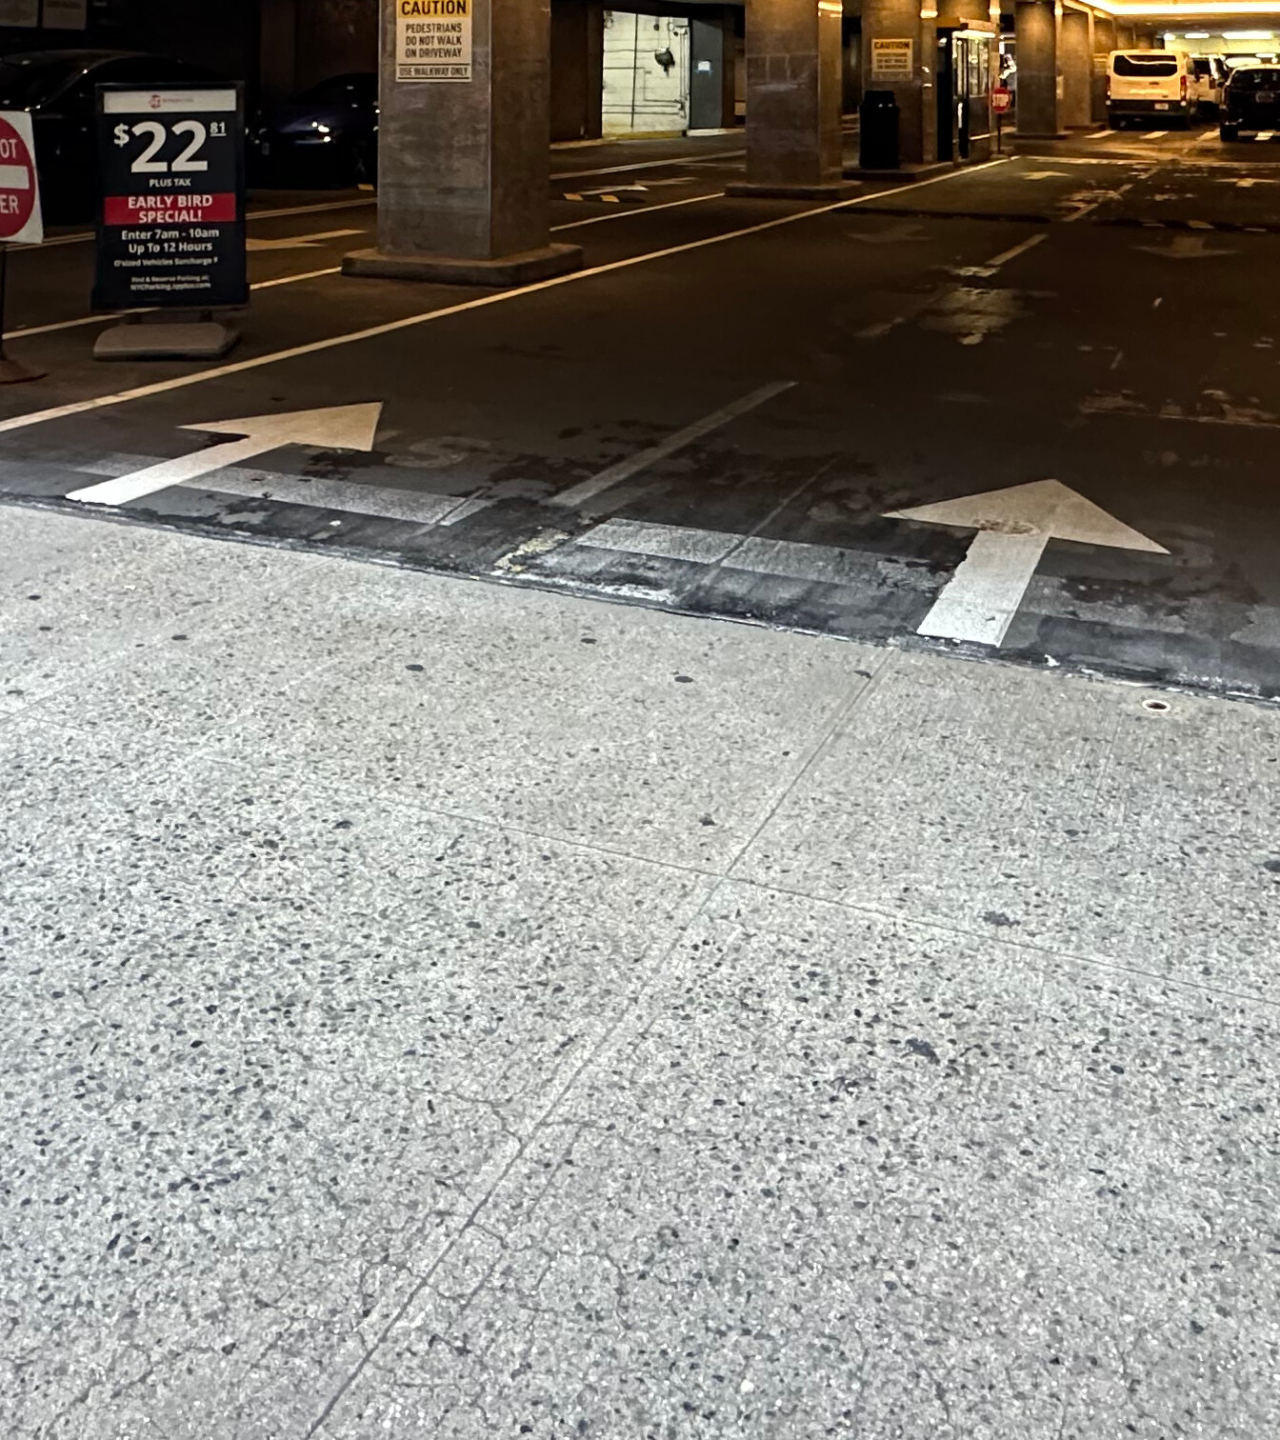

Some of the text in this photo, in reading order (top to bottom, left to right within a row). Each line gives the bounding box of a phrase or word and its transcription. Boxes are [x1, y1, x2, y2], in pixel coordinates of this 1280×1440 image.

[402, 0, 466, 16] CAUTION
[405, 23, 462, 34] PEDESTRIANS
[405, 35, 462, 46] DO NOT WALK
[874, 40, 910, 50] CAUTION
[405, 47, 462, 58] ON DRIVEWAY
[399, 66, 468, 76] USE WALKWAY ONLY
[148, 177, 192, 188] PLUS TAX
[127, 194, 214, 209] EARLY BIRD
[138, 209, 202, 224] SPECIAL!
[121, 230, 152, 241] Enter
[154, 229, 180, 240] 7am
[189, 228, 220, 239] 10am
[128, 242, 213, 256] Up To 12 Hours
[142, 257, 173, 267] Vehicles
[174, 256, 212, 267] Surcharge
